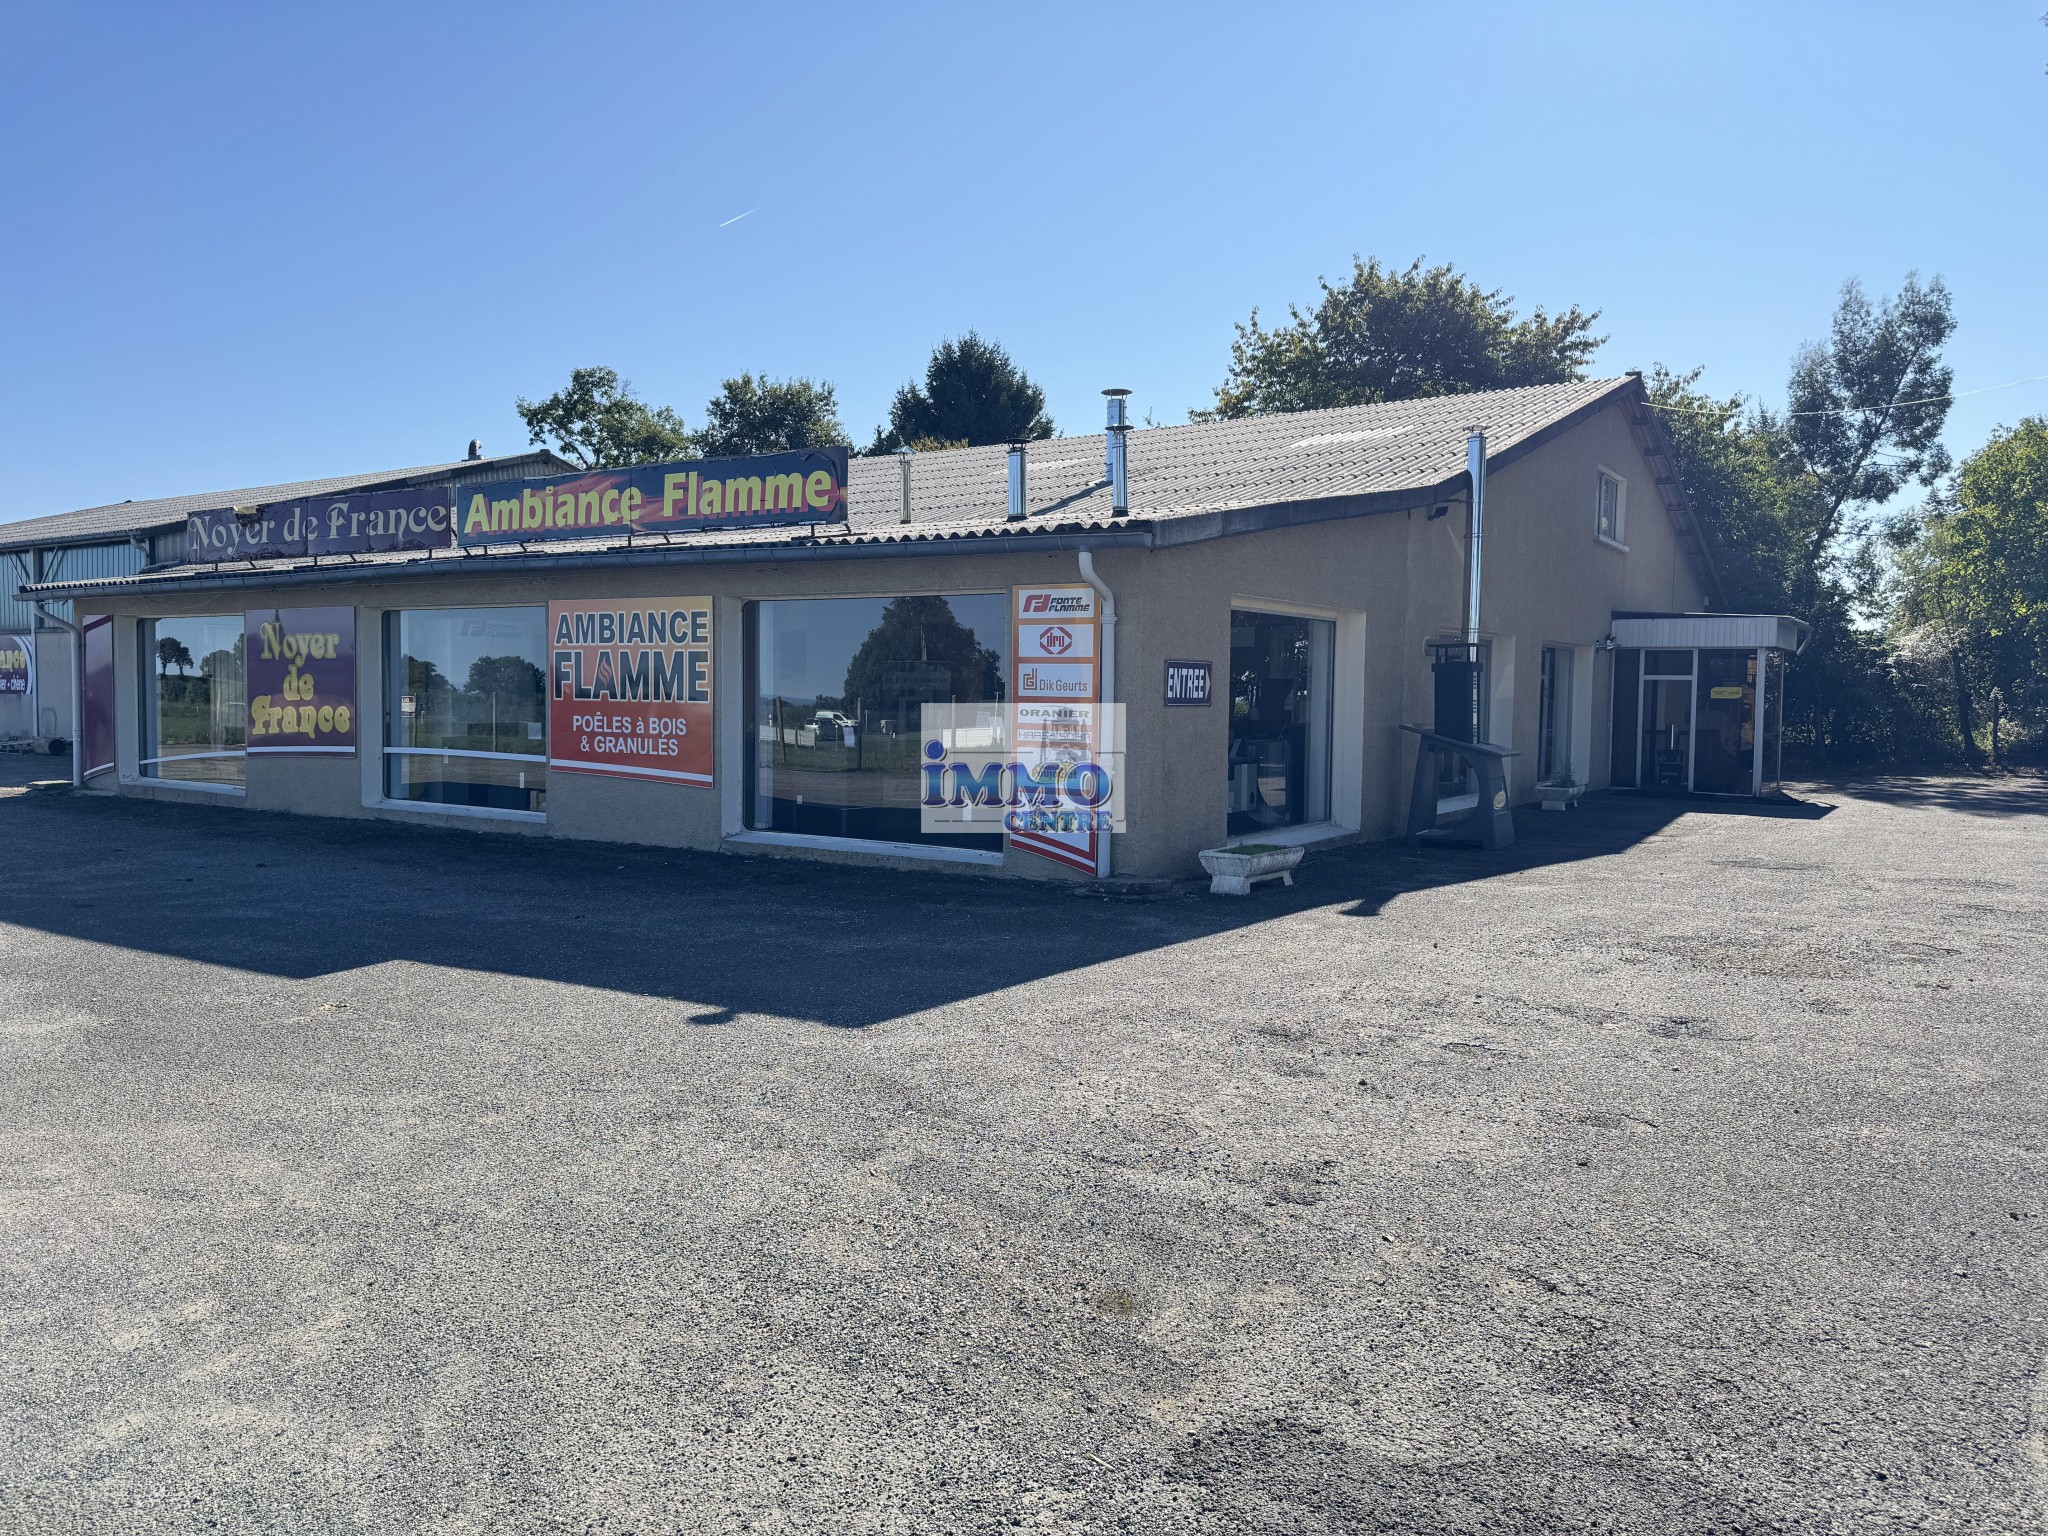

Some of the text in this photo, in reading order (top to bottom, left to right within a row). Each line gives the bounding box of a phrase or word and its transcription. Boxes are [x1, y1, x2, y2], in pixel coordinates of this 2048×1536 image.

[464, 470, 832, 534] Ambiance Flamme
[189, 502, 448, 555] Noyer de France
[1048, 604, 1091, 613] FLAMME
[1050, 596, 1083, 605] FONTE
[554, 609, 710, 646] AMBIANCE
[260, 622, 340, 668] Noyer
[283, 664, 315, 701] de
[553, 649, 711, 704] FLAMME
[1039, 678, 1088, 692] Dik Geurts
[1167, 667, 1205, 699] ENTREE
[251, 695, 350, 739] France
[572, 711, 687, 736] POÊLES à BOIS
[1019, 708, 1090, 719] ORANIER
[580, 734, 679, 756] & GRANULÉS
